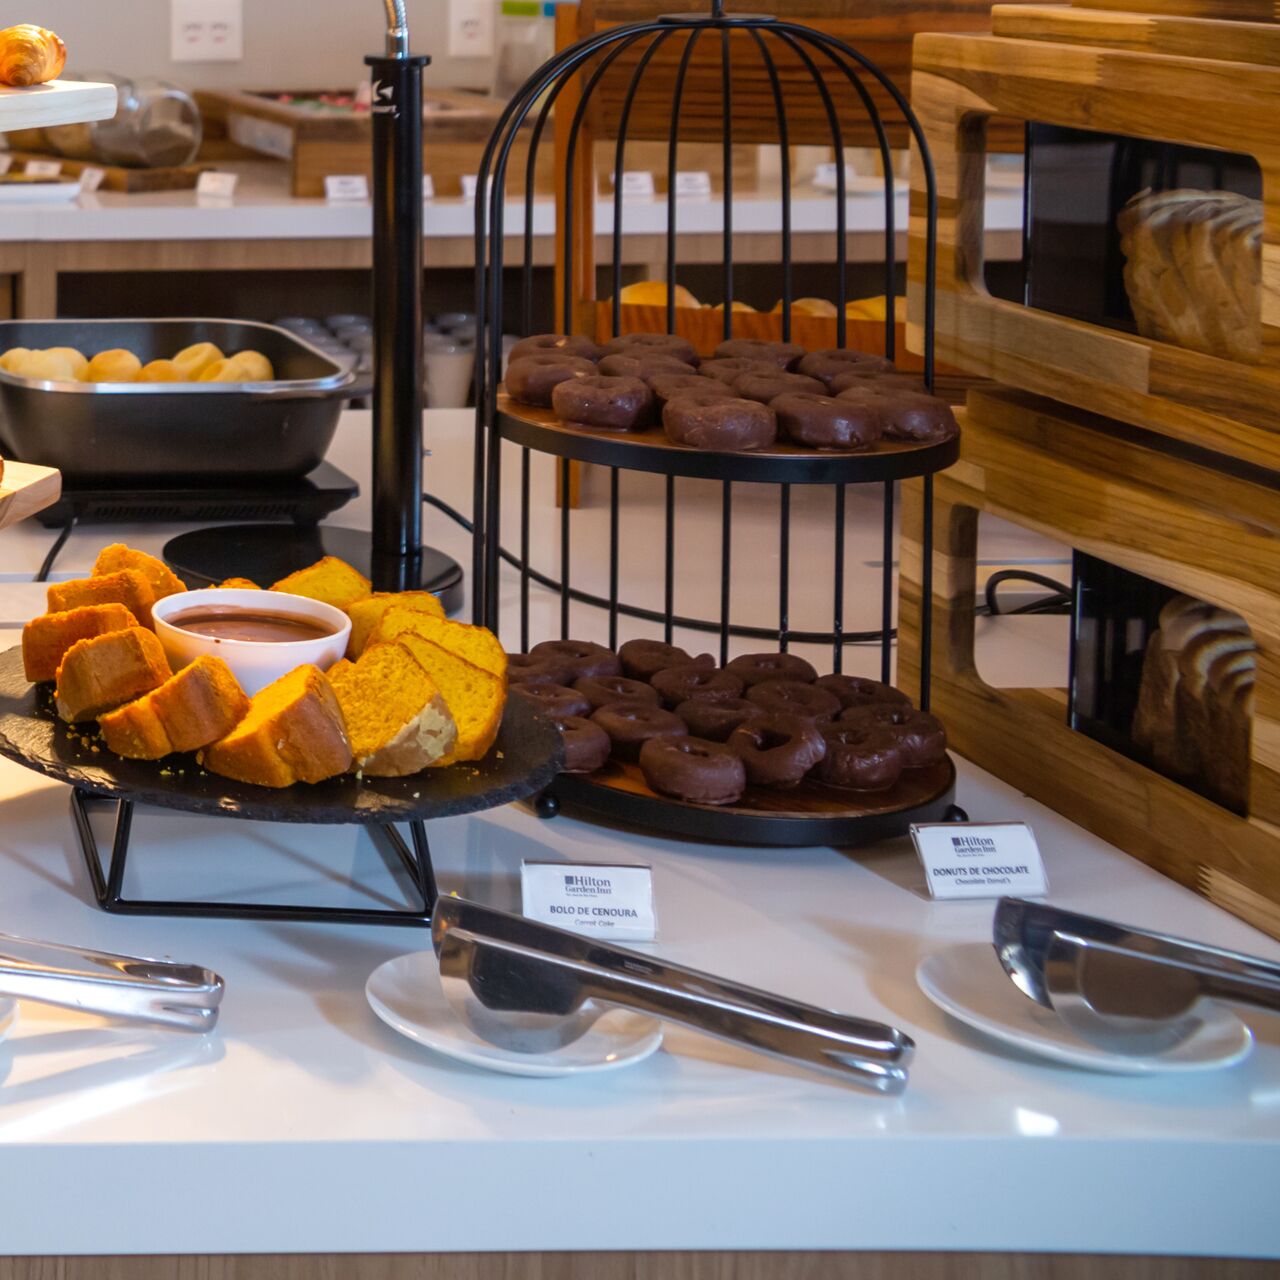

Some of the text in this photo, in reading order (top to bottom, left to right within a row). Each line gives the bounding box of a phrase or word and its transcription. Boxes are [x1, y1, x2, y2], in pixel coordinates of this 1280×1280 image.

[960, 836, 994, 846] Hilton
[933, 866, 1029, 876] DONUTS DE CHOCOLATE
[575, 875, 611, 887] Hilton
[565, 886, 612, 895] Garden Inn
[550, 905, 638, 918] BOLO DE CENOURA
